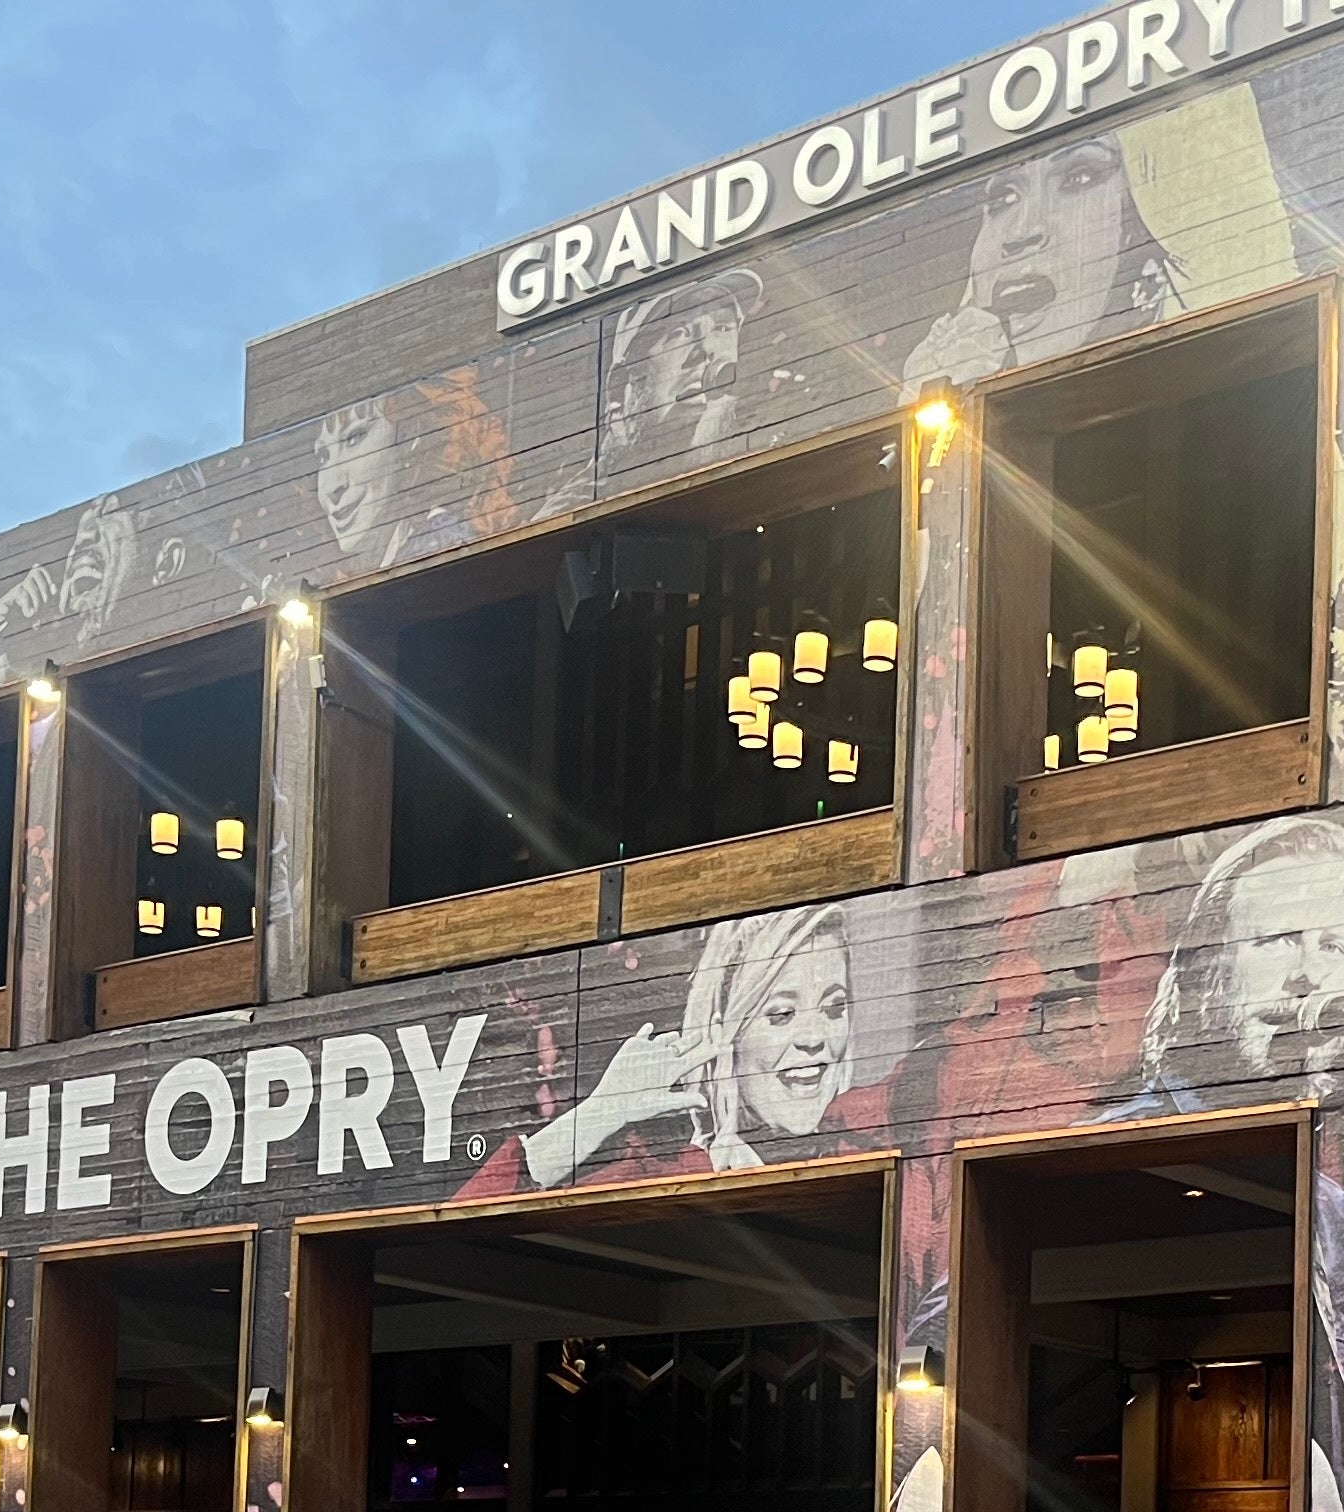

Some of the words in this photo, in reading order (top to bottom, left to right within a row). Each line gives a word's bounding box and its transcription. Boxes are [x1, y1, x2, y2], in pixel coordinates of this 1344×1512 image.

[500, 160, 771, 317] GRAND
[792, 85, 964, 208] OLE
[987, 0, 1238, 131] OPRY
[145, 1014, 488, 1195] OPRY
